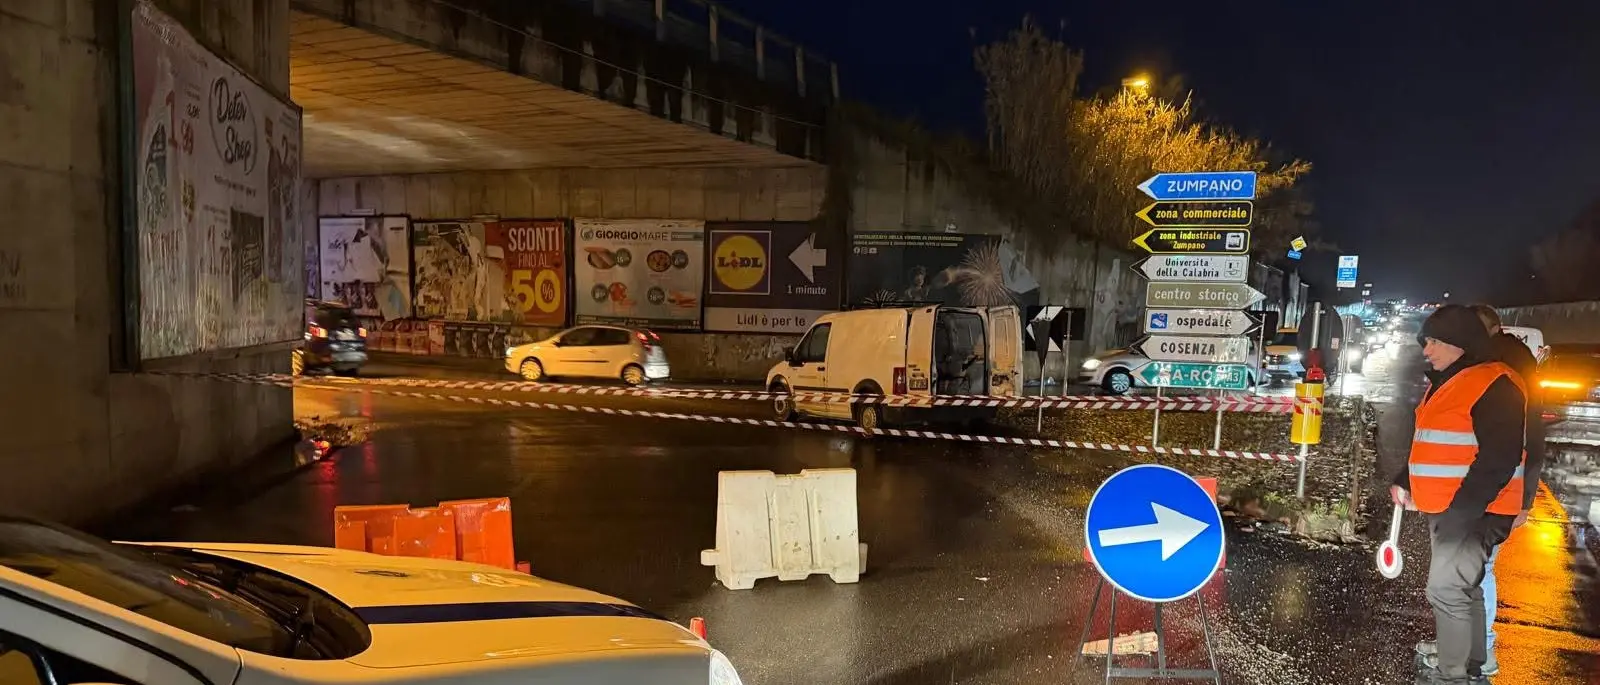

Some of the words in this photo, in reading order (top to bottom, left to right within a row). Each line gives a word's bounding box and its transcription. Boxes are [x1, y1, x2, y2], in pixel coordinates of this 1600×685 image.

[214, 76, 248, 123] Deter
[224, 125, 252, 172] Shop
[1167, 178, 1243, 193] ZUMPANO
[1155, 208, 1178, 219] zona
[1183, 206, 1247, 219] commerciale
[507, 226, 561, 252] SCONTI
[594, 229, 669, 242] GIORGIOMARE
[1159, 232, 1177, 240] zona
[1179, 231, 1222, 240] industriale
[1172, 241, 1206, 251] Zumpano
[518, 252, 538, 268] FINO
[538, 252, 551, 268] AL
[1156, 267, 1178, 277] della
[1182, 267, 1219, 277] Calabria
[510, 268, 561, 313] 50
[786, 284, 793, 294] 1
[795, 284, 827, 295] minuto
[1154, 289, 1191, 301] centro
[1198, 289, 1239, 302] storico
[736, 313, 757, 326] Lidl
[761, 313, 768, 326] è
[771, 316, 792, 328] per
[795, 313, 806, 326] te
[1176, 314, 1232, 329] ospedale
[1160, 341, 1216, 355] COSENZA
[1162, 368, 1213, 382] A-RC
